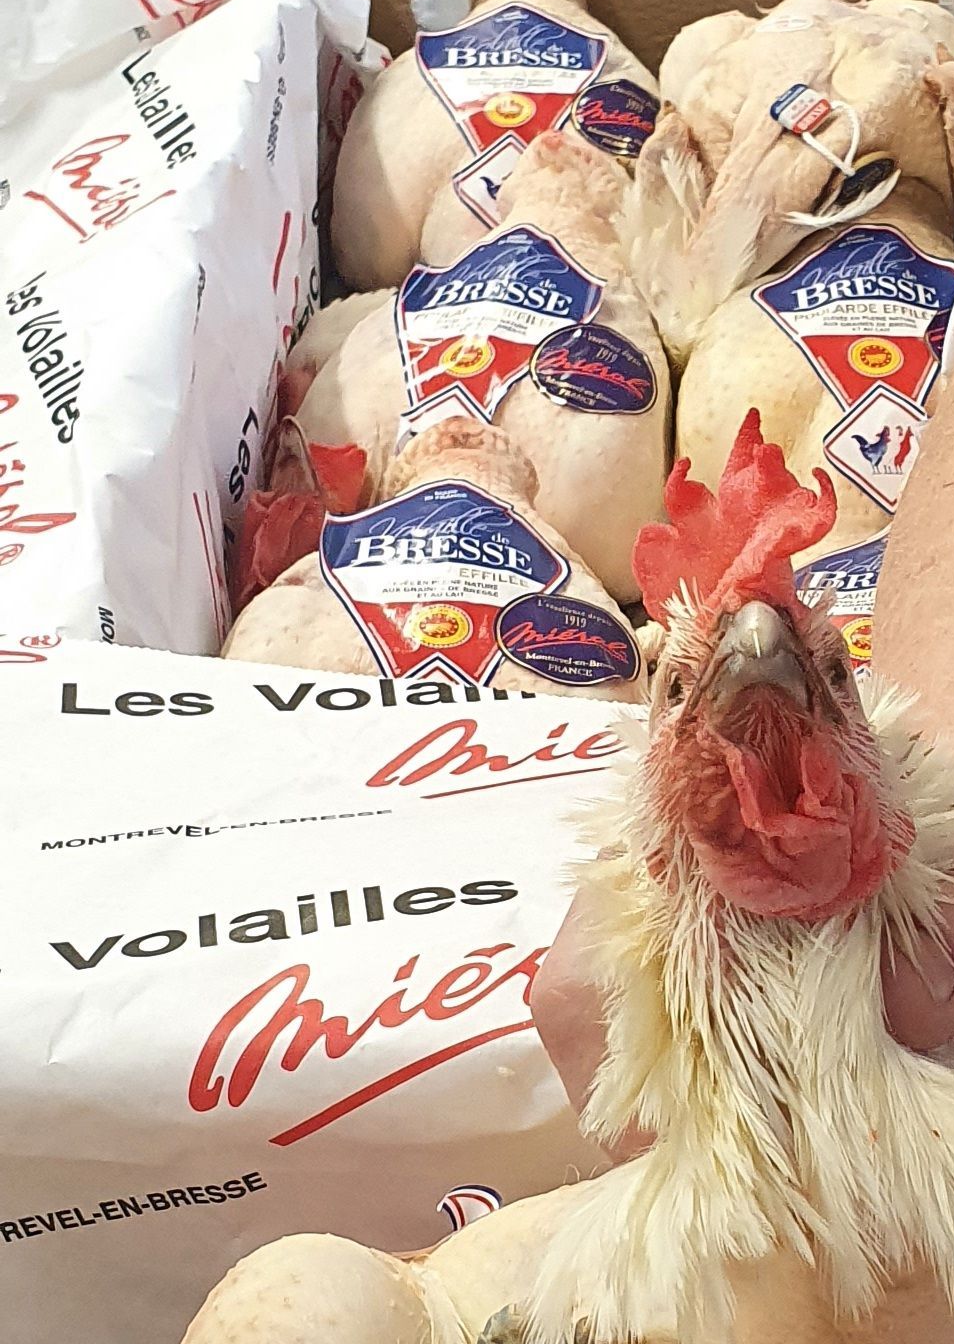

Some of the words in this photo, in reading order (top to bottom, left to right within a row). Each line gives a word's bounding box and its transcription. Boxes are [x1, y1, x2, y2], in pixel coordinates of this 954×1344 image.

[444, 47, 584, 70] BRESSE
[422, 280, 574, 317] BRESSE
[791, 275, 940, 311] BRESSE
[351, 535, 534, 576] BRESSE
[491, 532, 511, 545] de
[564, 614, 587, 628] 1919
[59, 681, 215, 717] Les
[49, 879, 519, 972] Volailles
[0, 1170, 269, 1244] REVEL-EN-BRESSE
